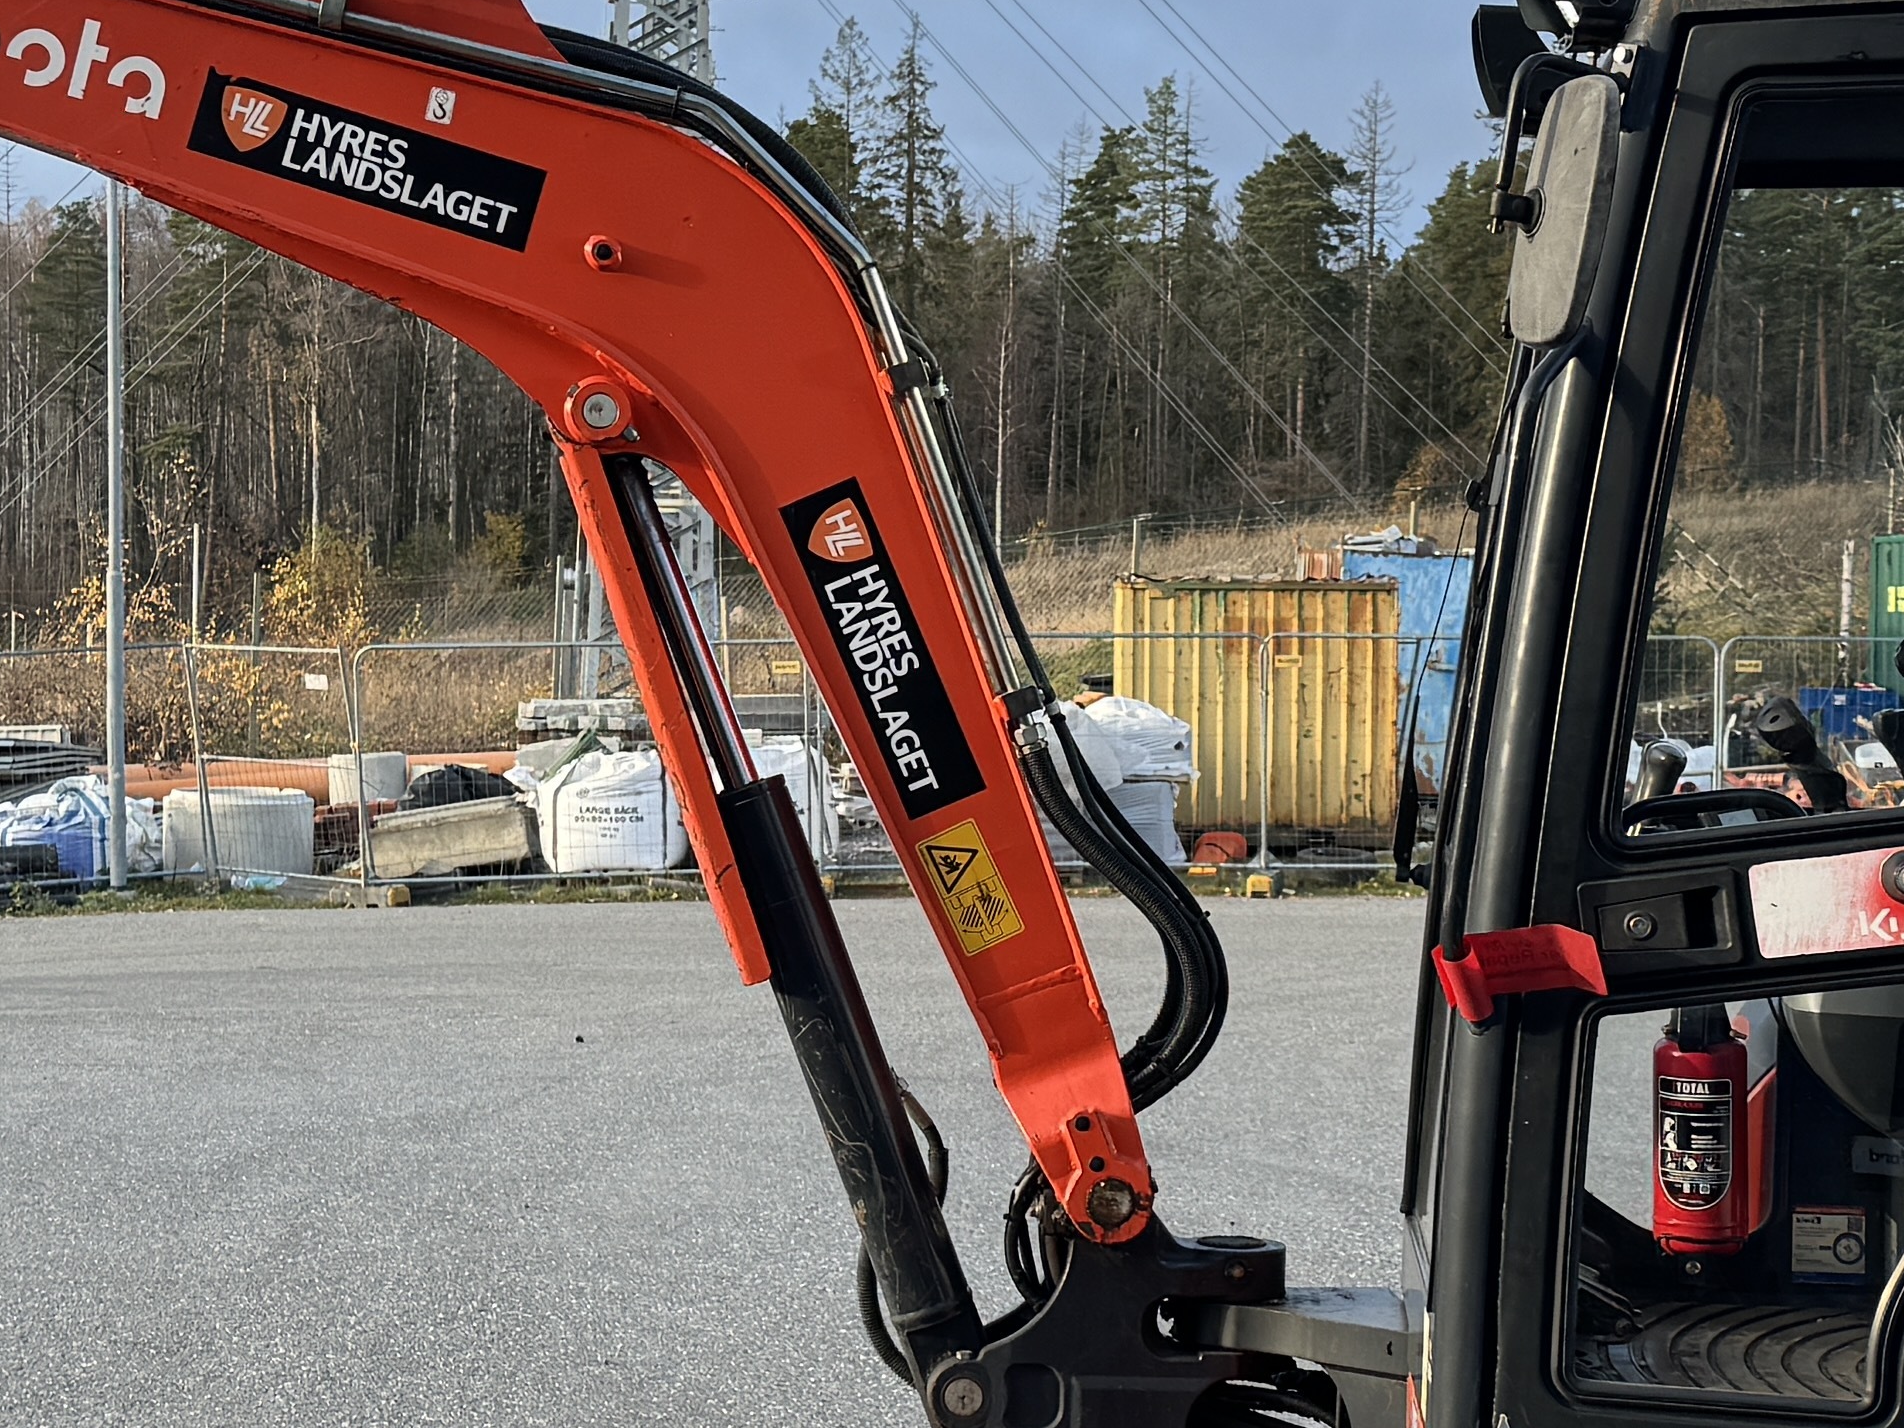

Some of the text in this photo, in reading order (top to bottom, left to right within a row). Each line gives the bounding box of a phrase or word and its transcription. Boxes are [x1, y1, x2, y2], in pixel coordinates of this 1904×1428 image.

[281, 137, 518, 234] LANDSLAGET
[290, 108, 409, 169] HYRES
[852, 564, 920, 677] HYRES
[824, 575, 939, 792] LANDSLAGET
[1675, 1081, 1710, 1094] TOTAL
